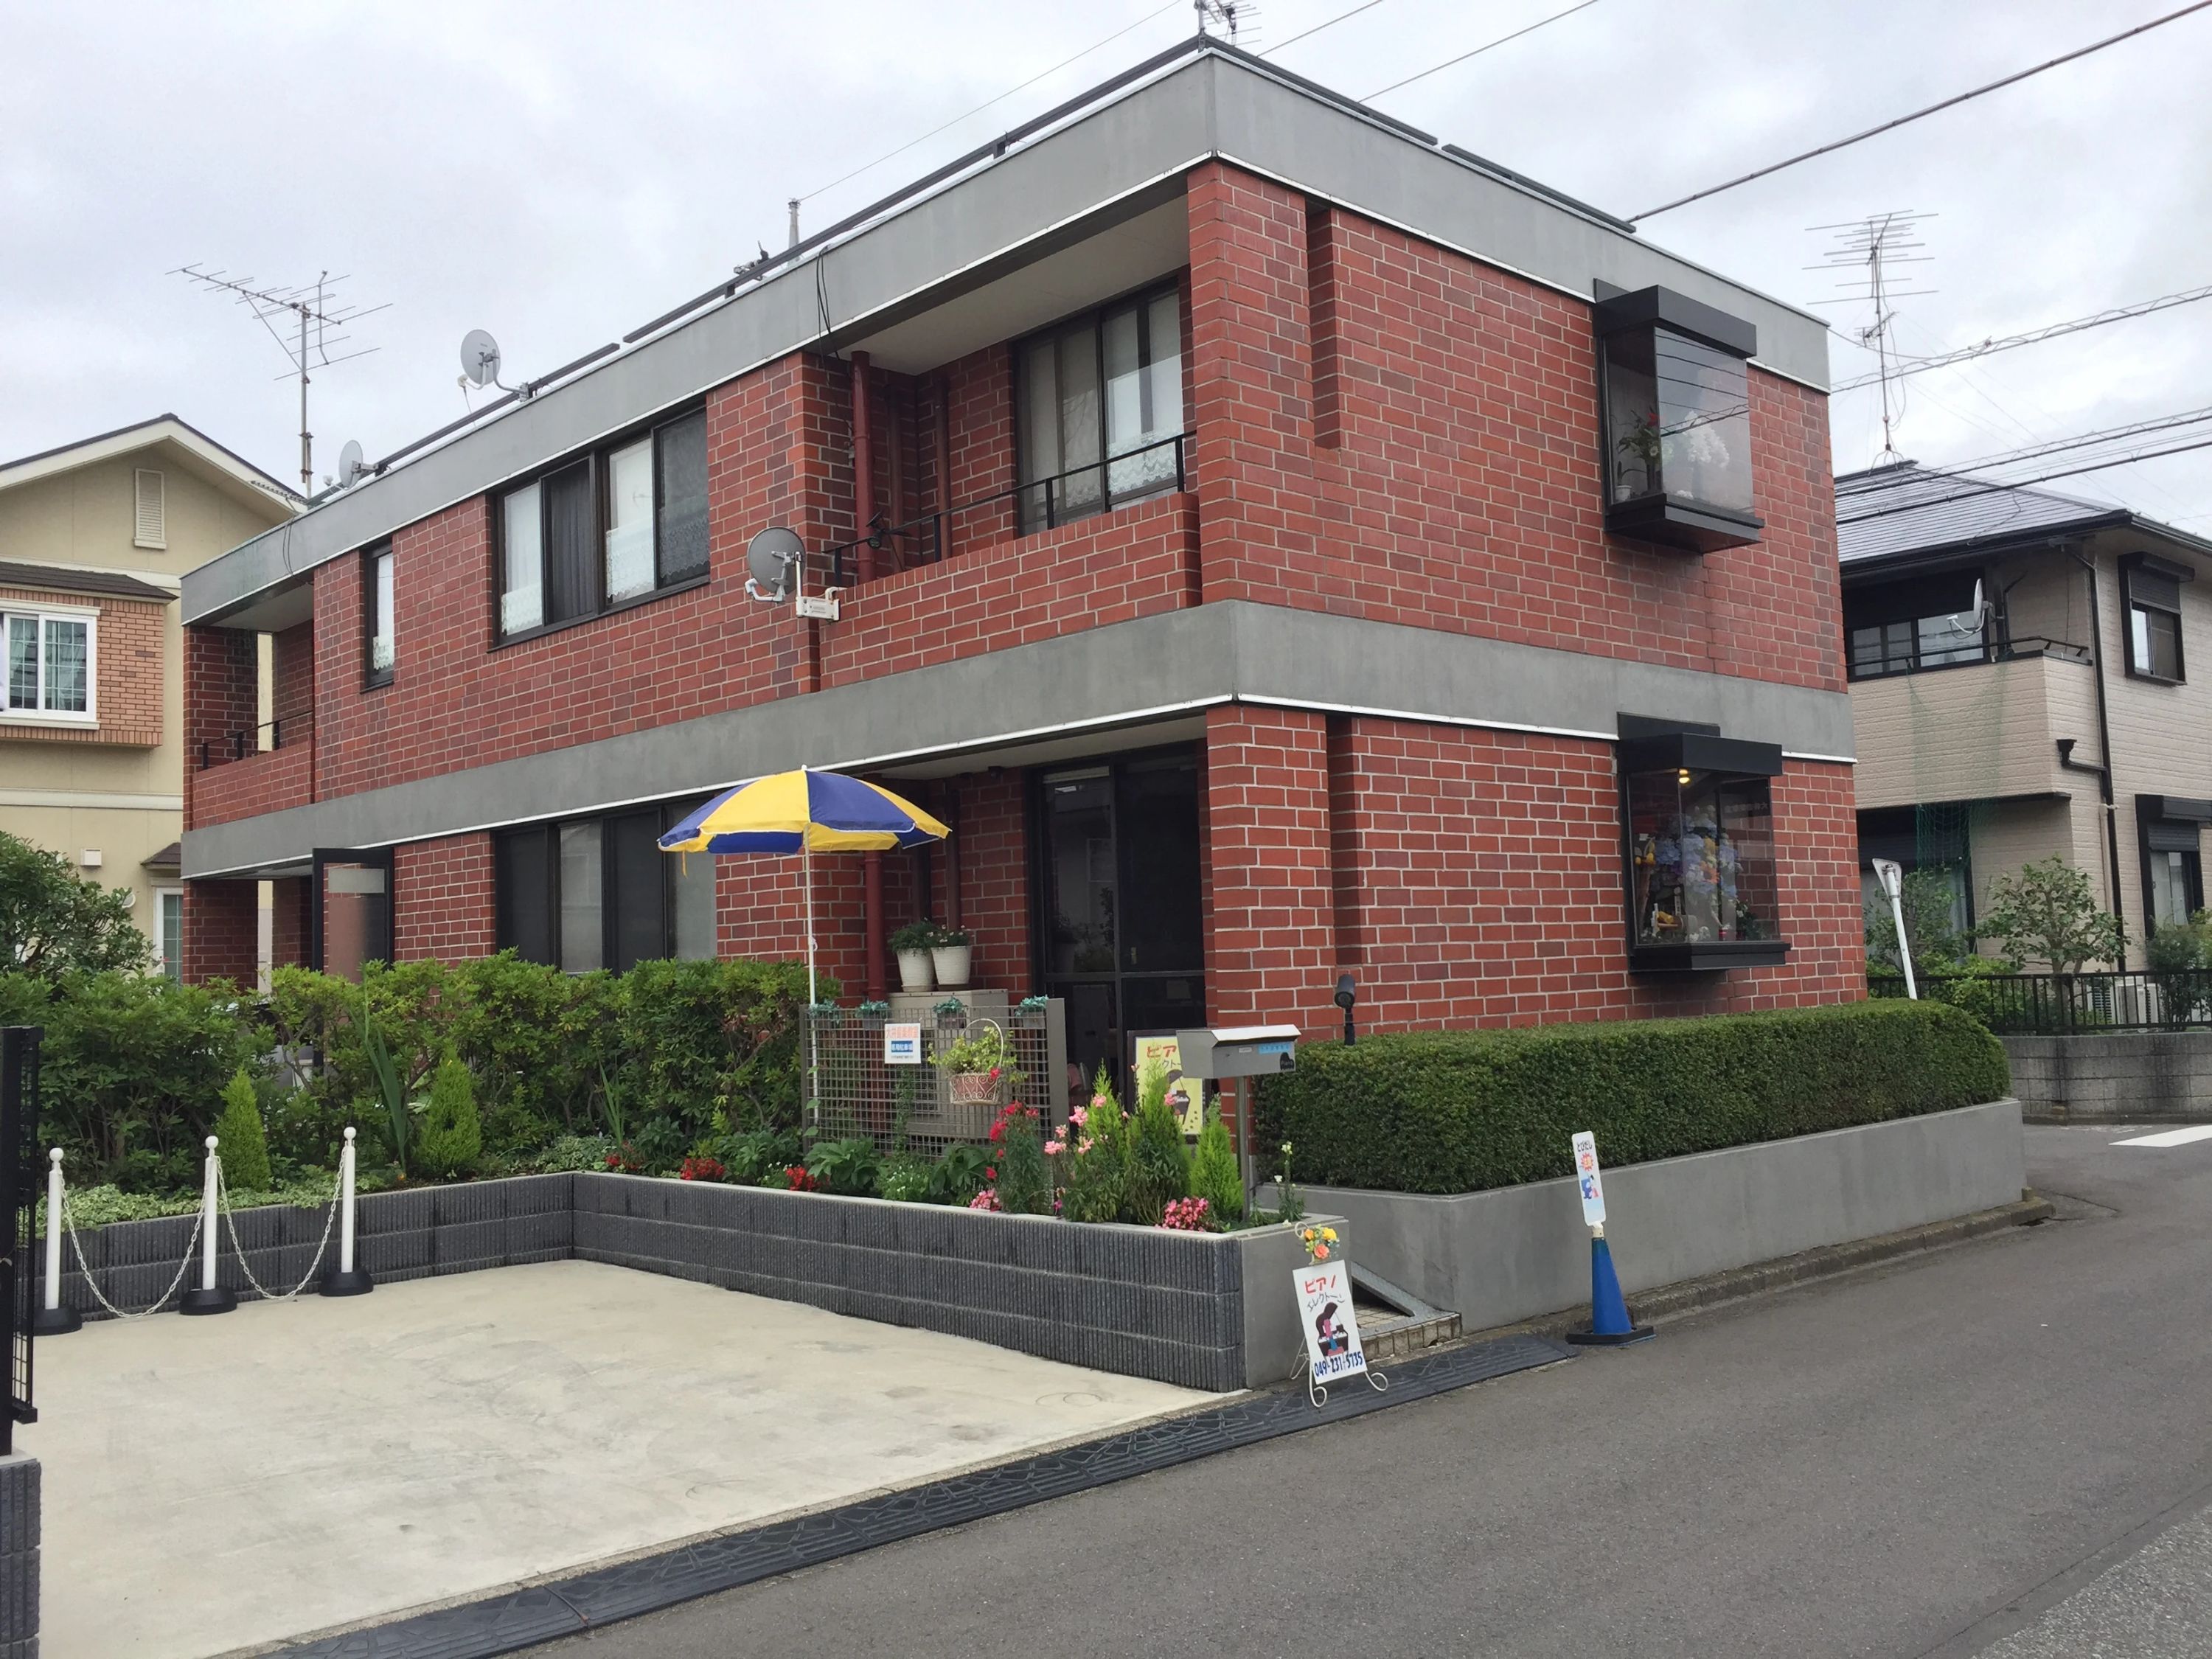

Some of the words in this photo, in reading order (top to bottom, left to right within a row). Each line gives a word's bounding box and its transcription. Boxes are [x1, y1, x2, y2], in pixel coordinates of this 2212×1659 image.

[1147, 1044, 1177, 1058] ピア
[1304, 1274, 1336, 1294] ピアノ
[1307, 1292, 1346, 1312] エレクトーン
[1314, 1351, 1363, 1377] 049-231-5735
